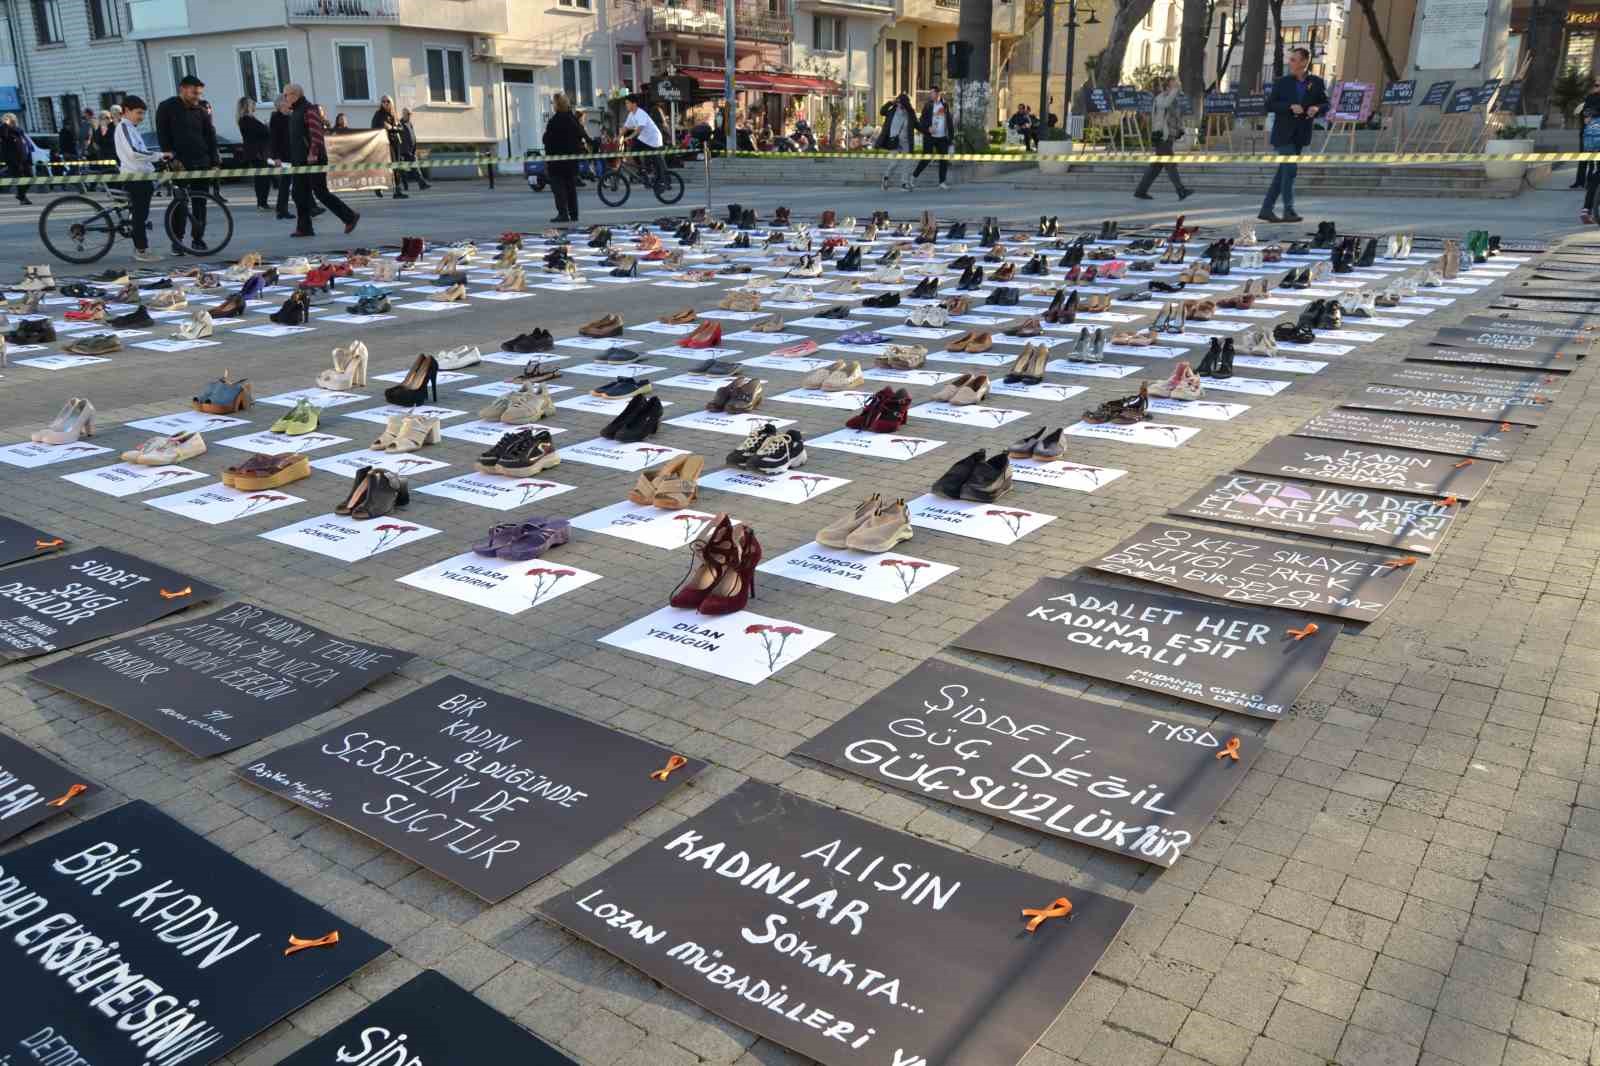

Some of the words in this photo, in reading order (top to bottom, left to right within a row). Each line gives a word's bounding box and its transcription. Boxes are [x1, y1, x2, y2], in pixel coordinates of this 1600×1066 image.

[1344, 449, 1431, 467] KADIN
[1192, 538, 1259, 557] KEZ
[1240, 563, 1351, 591] ERKEK
[1048, 592, 1182, 625] ADALET
[1196, 616, 1270, 644] HER
[1288, 590, 1384, 612] OLMAZ
[646, 628, 720, 653] YENİGÜN
[673, 621, 725, 640] DİLAN
[1027, 606, 1149, 642] KADINA
[1066, 631, 1187, 667] OLMALI
[439, 719, 522, 753] KADIN
[1148, 720, 1220, 748] TYSD
[321, 732, 480, 804] SESSİZLİK
[467, 788, 529, 822] DE
[887, 717, 993, 760] GÜÇ
[1010, 753, 1176, 815] DEĞİL
[663, 829, 870, 937] KADINLAR
[575, 888, 667, 944] LOZAN
[666, 940, 877, 1049] MÜBADİLLERİ
[740, 912, 925, 1014] SOKAKTA...
